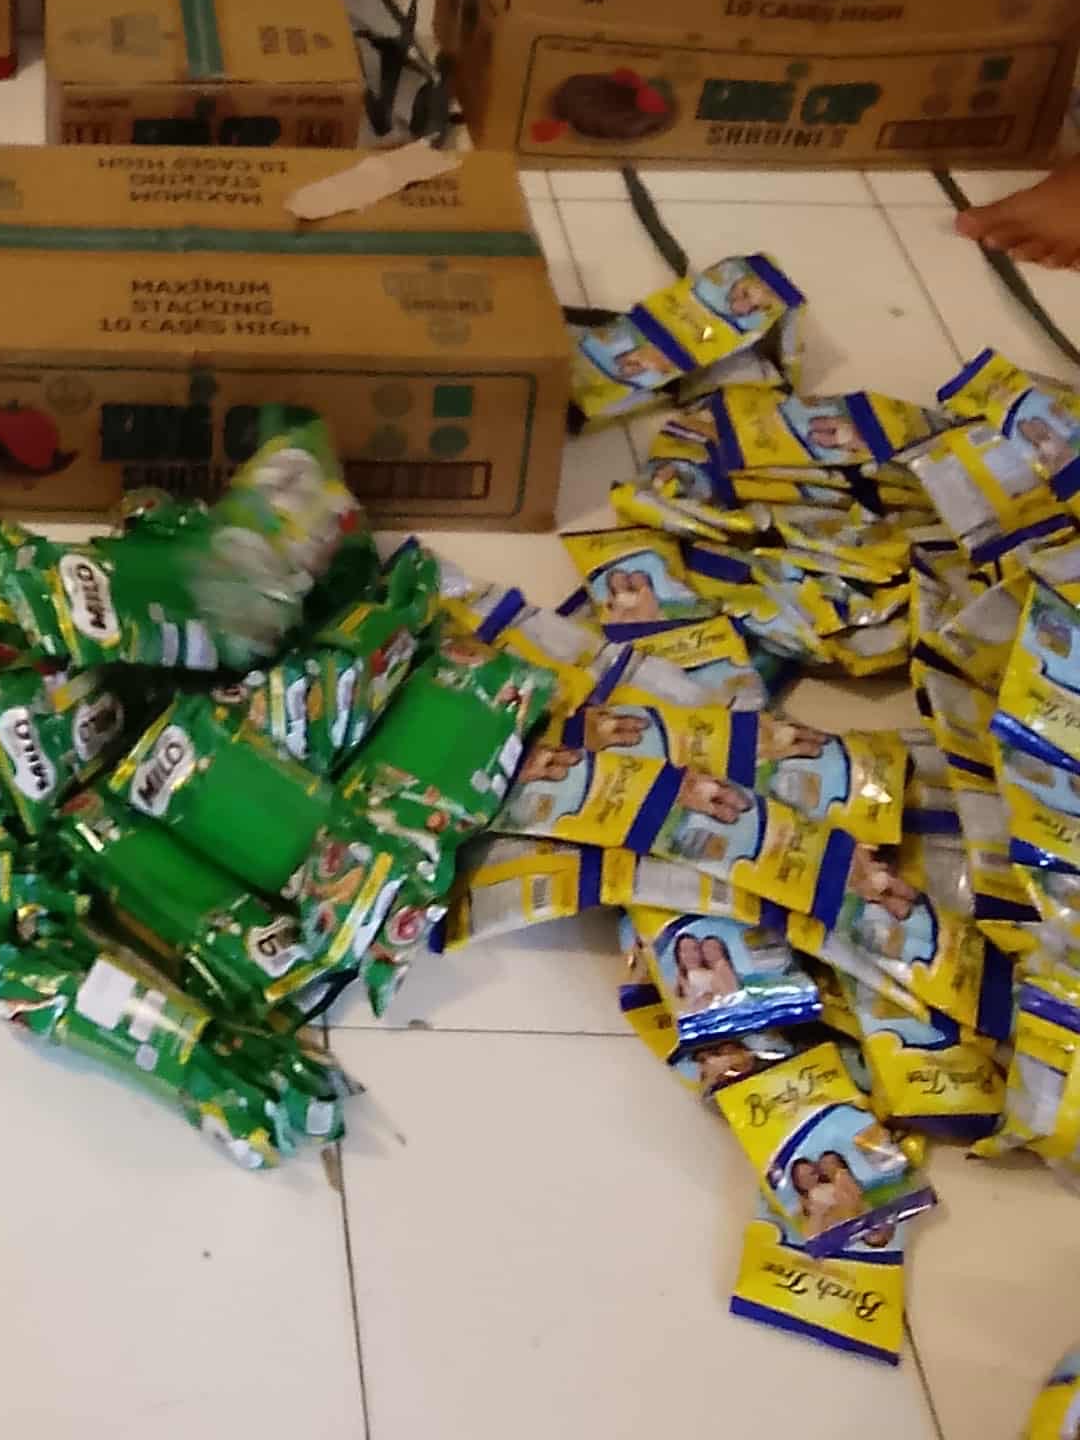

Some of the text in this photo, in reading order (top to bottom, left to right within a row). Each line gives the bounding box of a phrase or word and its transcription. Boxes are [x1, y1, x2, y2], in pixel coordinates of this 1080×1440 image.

[130, 279, 271, 295] MAXIMUM
[131, 298, 273, 315] STACKING
[75, 563, 108, 631] MILO
[136, 740, 186, 805] MILO
[762, 1262, 887, 1322] Birch Tree
